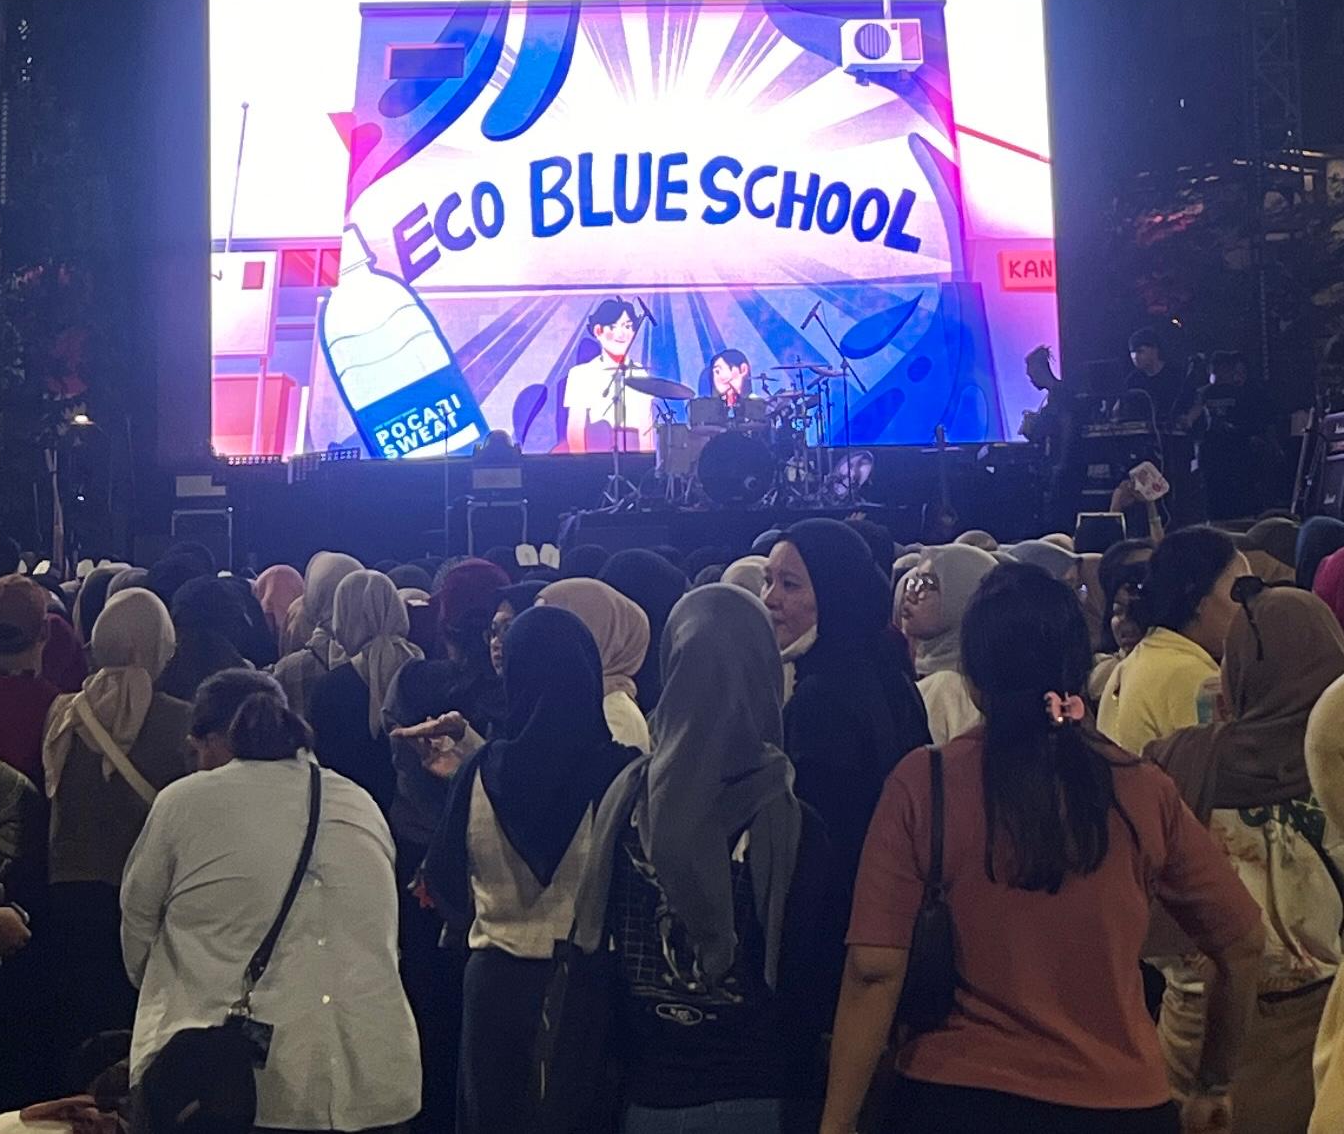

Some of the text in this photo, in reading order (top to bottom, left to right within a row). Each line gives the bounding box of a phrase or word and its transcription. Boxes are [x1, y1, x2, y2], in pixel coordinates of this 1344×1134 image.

[393, 151, 922, 283] ECO BLUE SCHOOL
[1009, 260, 1052, 278] KAN
[376, 393, 461, 446] POCARI
[383, 411, 458, 459] SWEAT
